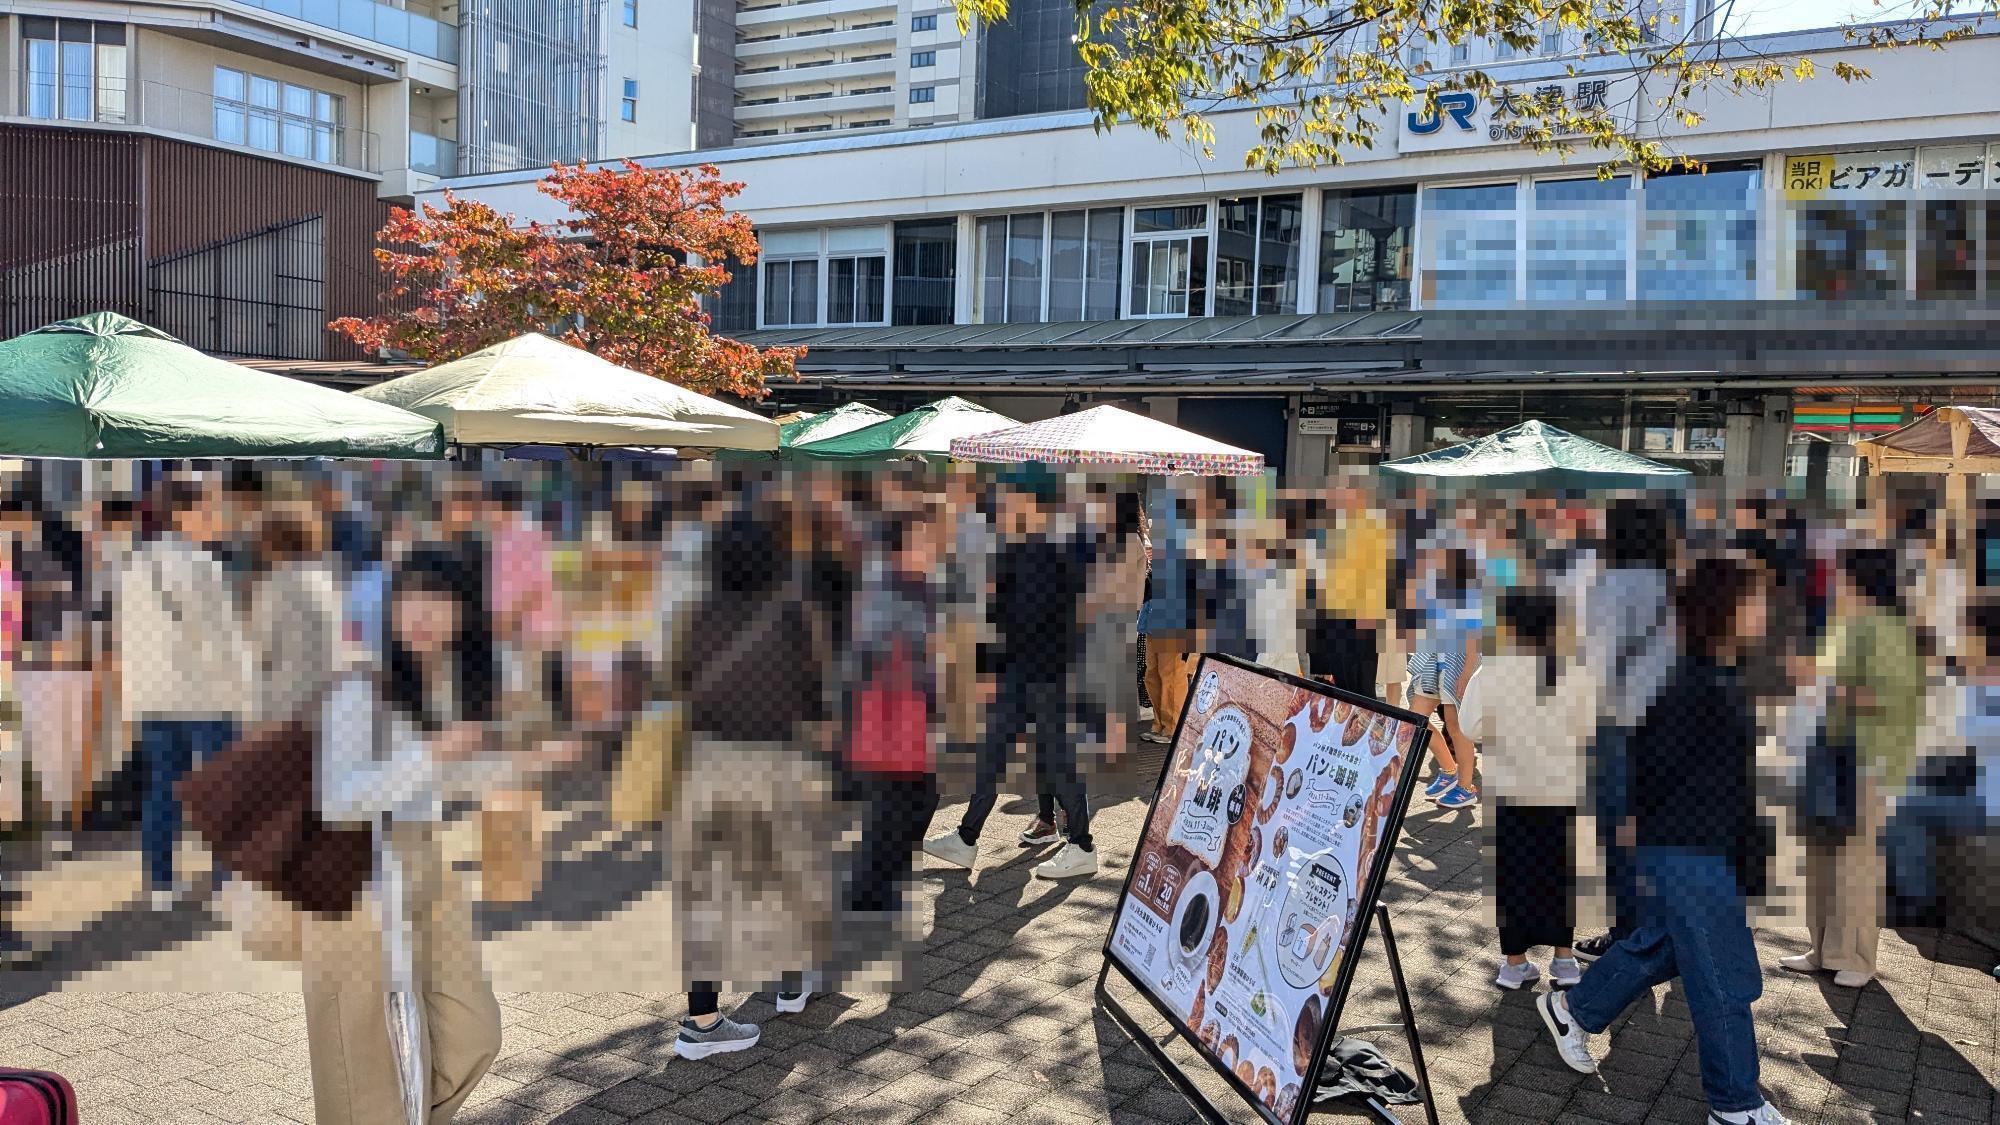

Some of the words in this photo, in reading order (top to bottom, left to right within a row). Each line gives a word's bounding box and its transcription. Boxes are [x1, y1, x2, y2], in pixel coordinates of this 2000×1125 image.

[1408, 92, 1478, 135] JR
[1791, 161, 1821, 176] 当日
[1791, 177, 1823, 189] OK!
[1305, 753, 1360, 791] パンと珈琲
[1256, 871, 1277, 892] MAP
[1316, 867, 1337, 884] PRESENT
[1160, 882, 1173, 902] 20
